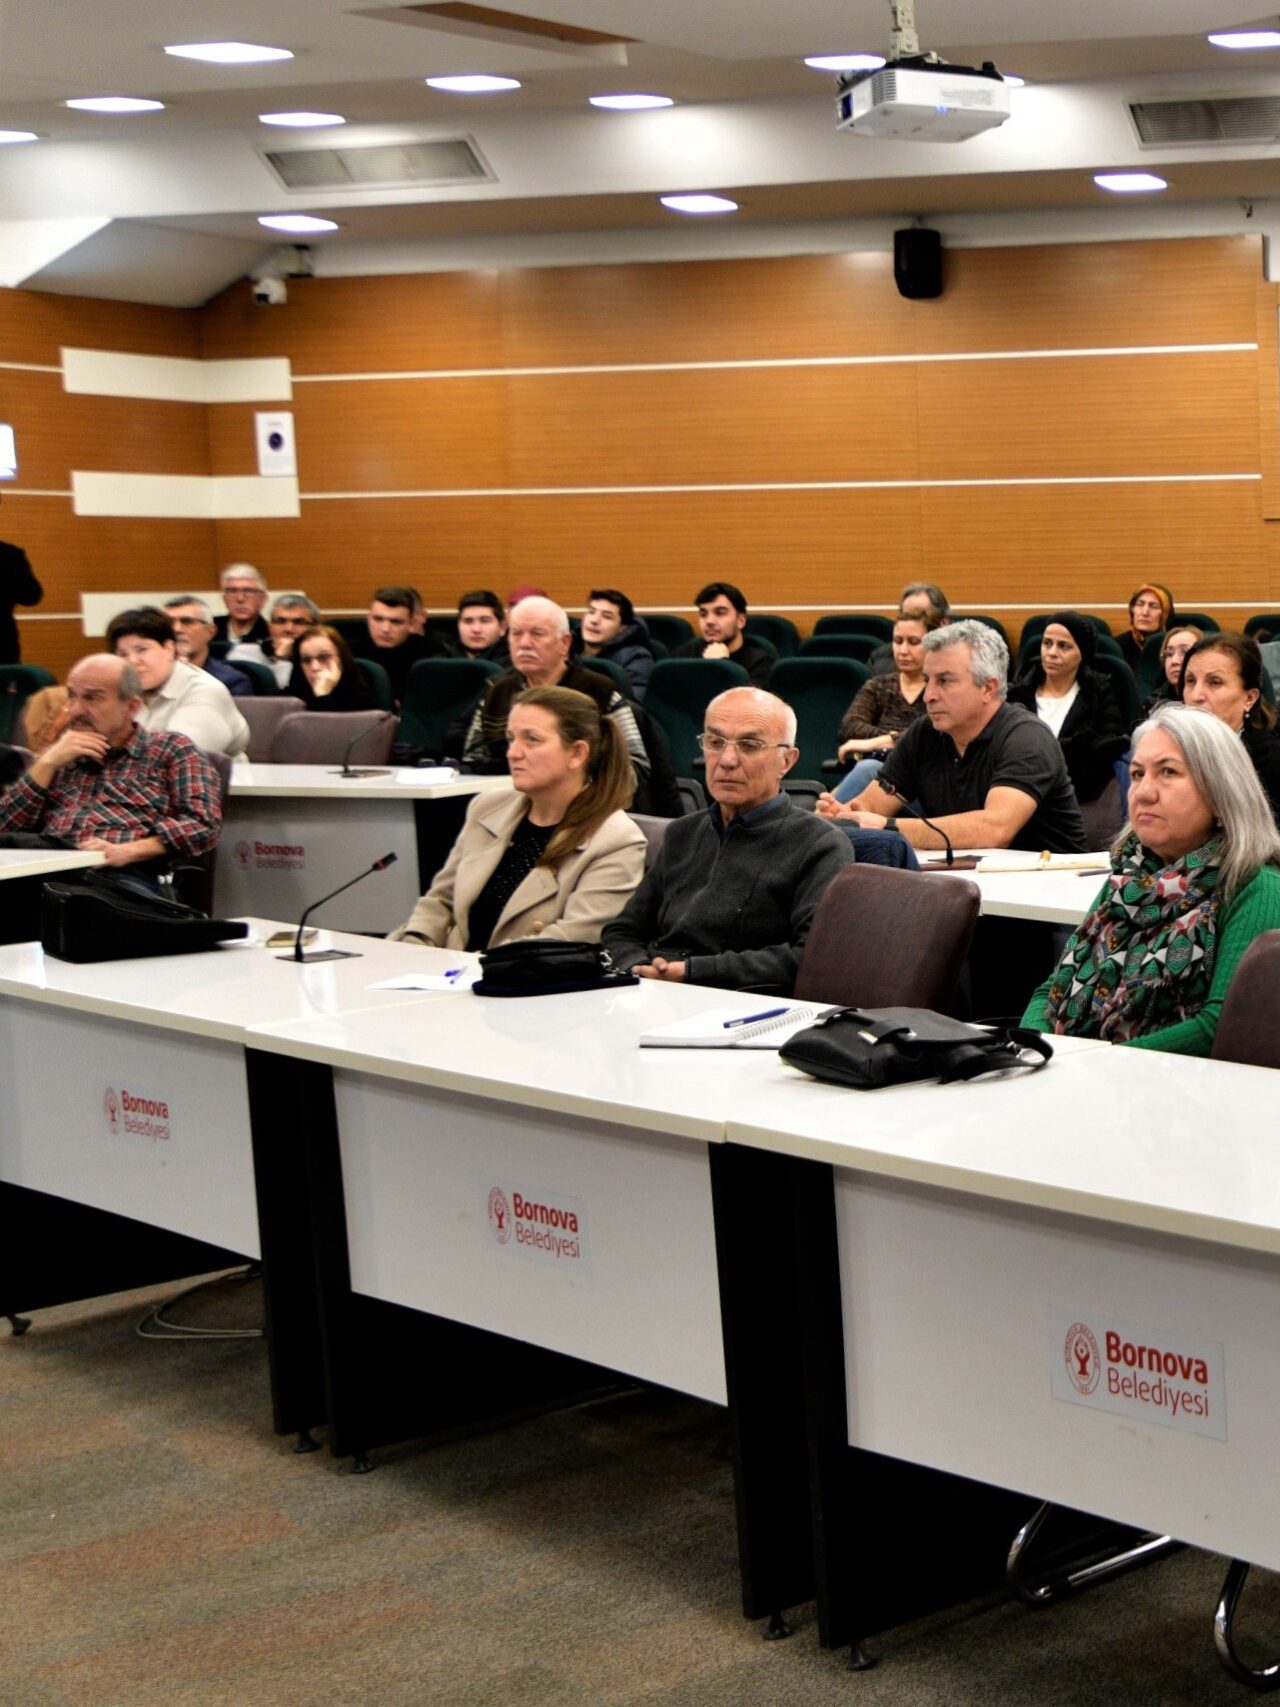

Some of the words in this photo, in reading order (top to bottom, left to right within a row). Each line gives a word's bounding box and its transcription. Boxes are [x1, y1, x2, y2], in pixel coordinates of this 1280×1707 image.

[254, 841, 305, 857] Bornova
[122, 1090, 169, 1119] Bornova
[124, 1114, 171, 1143] Belediyesi
[513, 1192, 579, 1233] Bornova
[515, 1221, 580, 1258] Belediyesi
[1106, 1331, 1208, 1384] Bornova
[1107, 1367, 1209, 1416] Belediyesi
